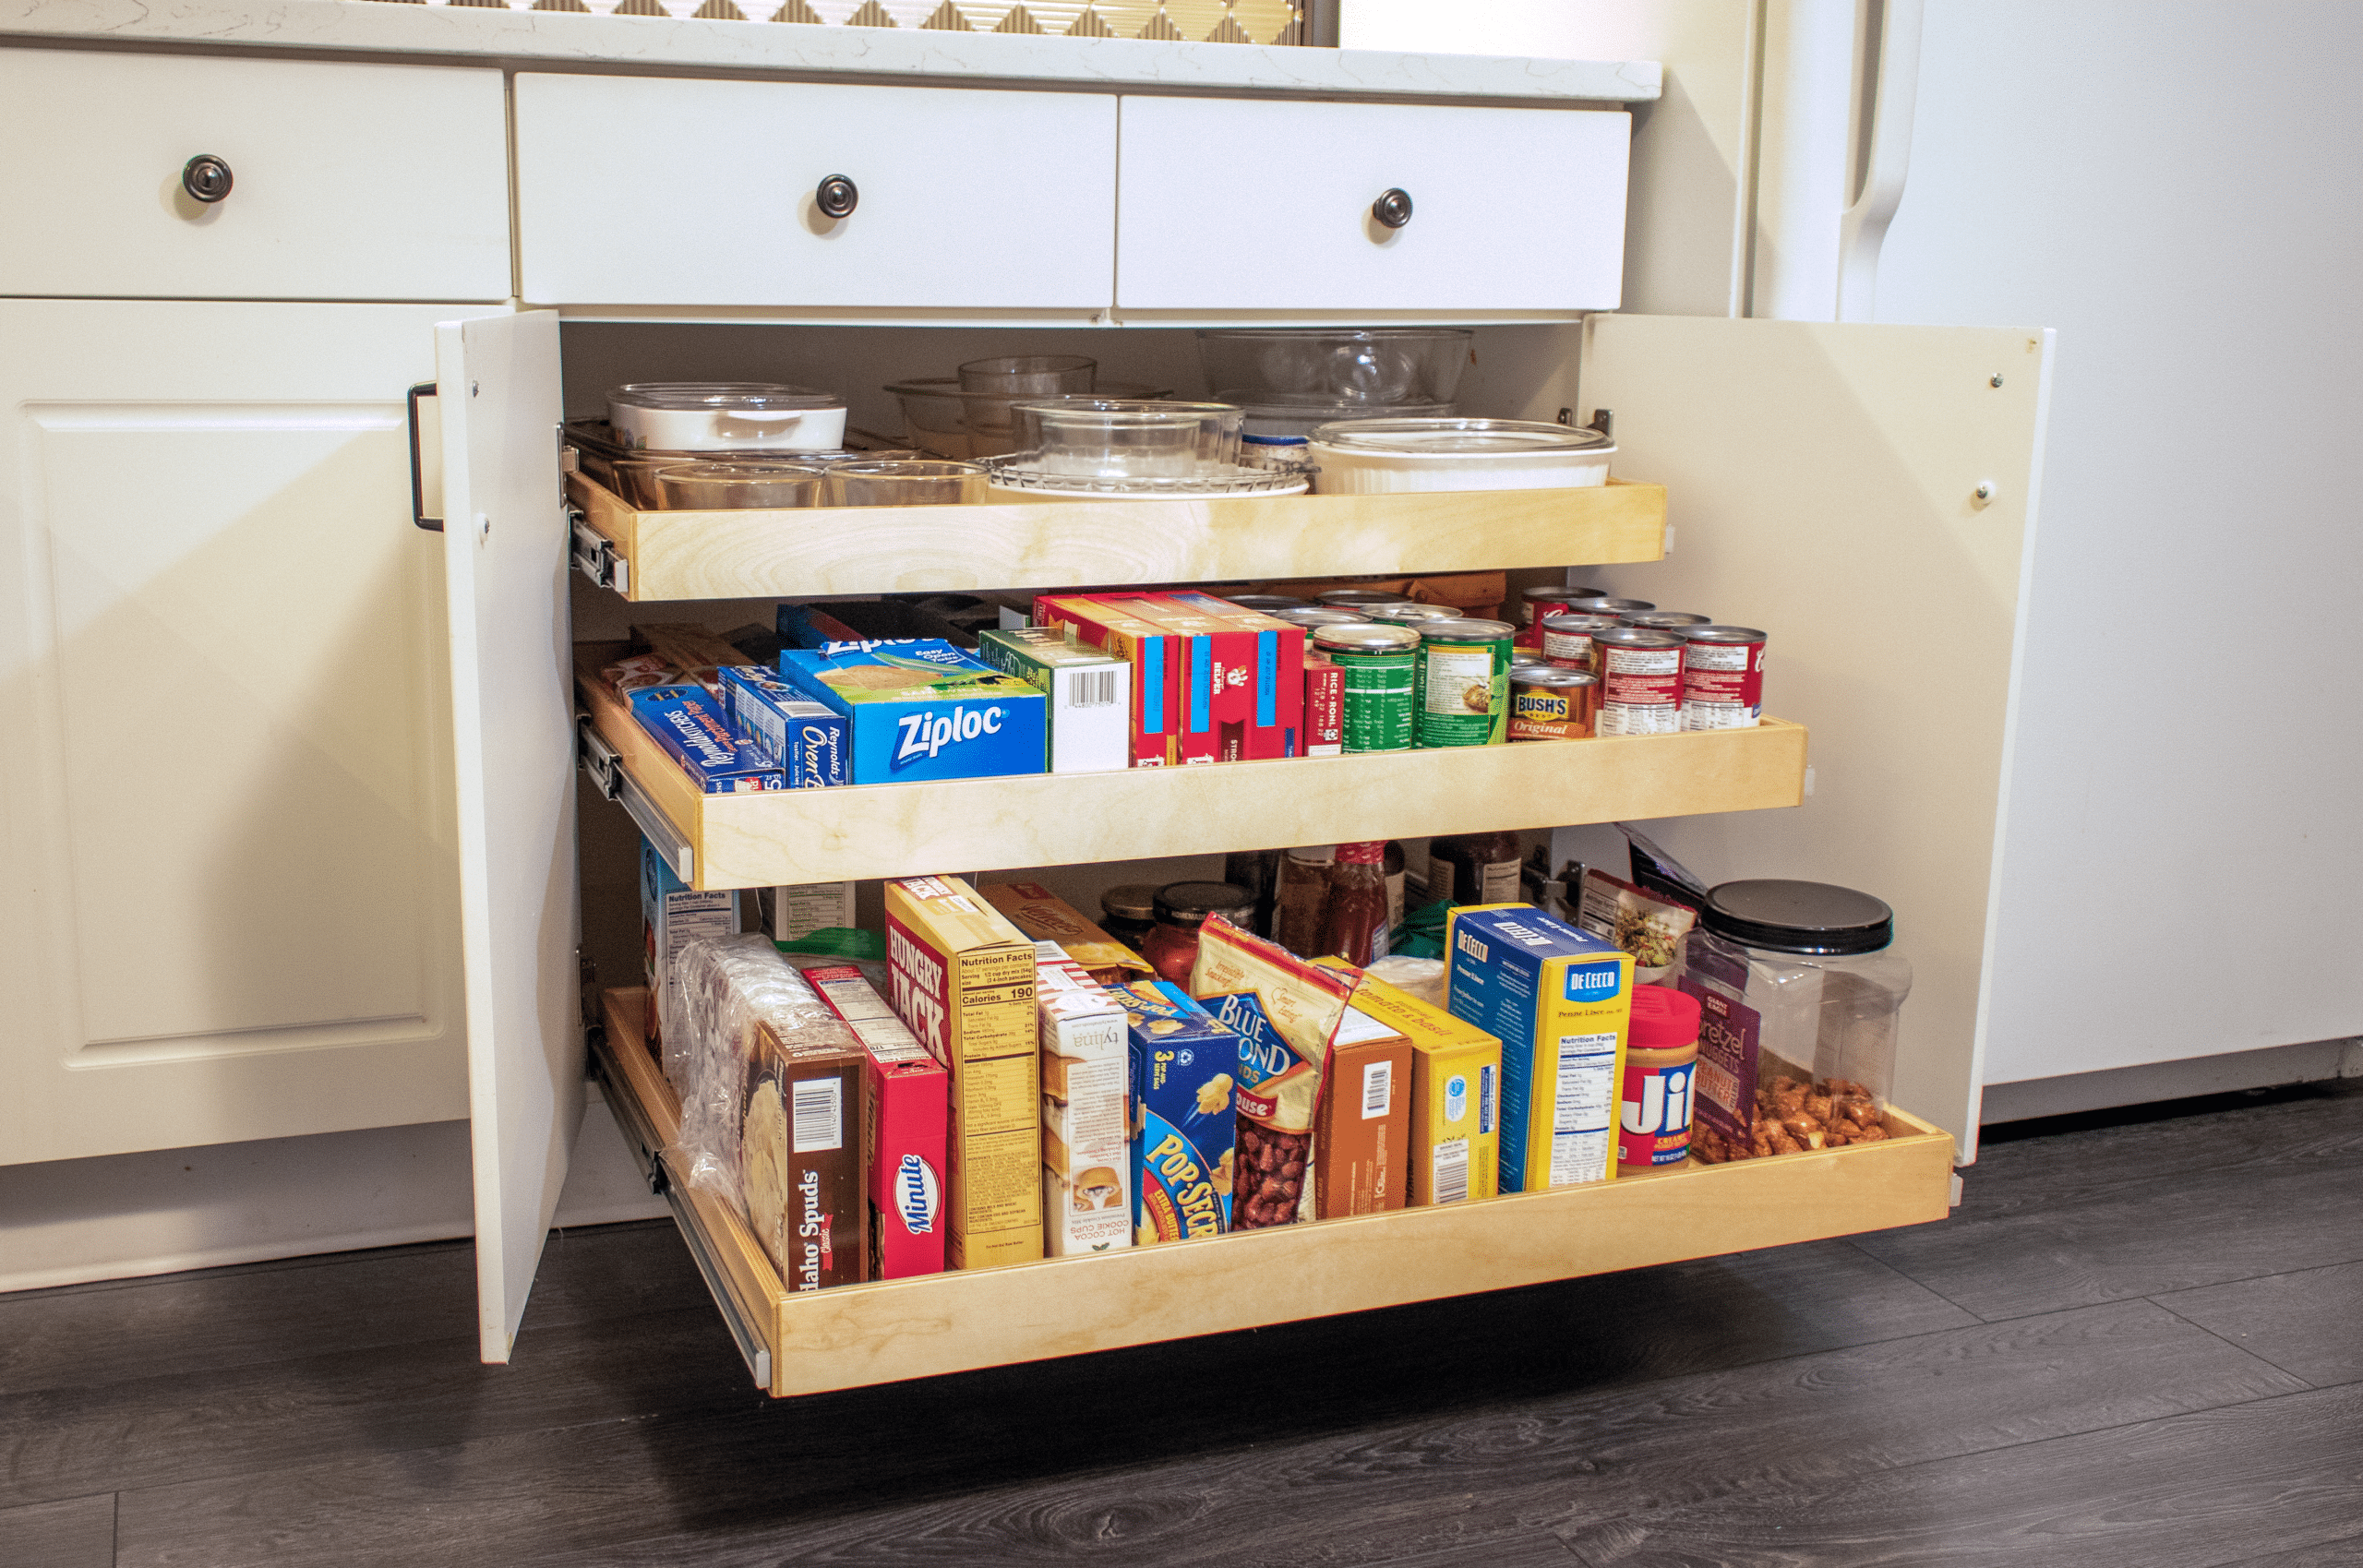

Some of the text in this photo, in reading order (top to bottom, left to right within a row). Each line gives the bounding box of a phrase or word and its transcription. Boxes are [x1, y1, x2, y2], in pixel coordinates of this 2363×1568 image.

[916, 648, 942, 657] Easy
[923, 652, 956, 662] Open
[1212, 661, 1222, 695] HELPER
[1329, 672, 1338, 695] RICE
[1518, 696, 1567, 715] BUSH'S
[664, 710, 703, 743] KITCHENS
[898, 706, 1002, 760] Ziploc
[1514, 720, 1568, 736] Original
[802, 725, 828, 775] Oven
[827, 725, 841, 775] Reynolds
[668, 891, 726, 902] Nutrition Facts
[890, 925, 942, 999] HUNGRY
[961, 952, 1033, 966] Nutrition Facts
[962, 973, 980, 981] Serving
[1571, 972, 1615, 990] DE CECCO
[962, 987, 1033, 1004] Calories 190
[1277, 990, 1298, 1008] Smart
[1708, 995, 1728, 1010] GIANT
[891, 963, 949, 1069] JACK
[1217, 994, 1267, 1044] BLUE
[1356, 987, 1404, 1014] tomato
[1412, 1018, 1454, 1036] basil
[1708, 1001, 1728, 1017] EAGLE
[1074, 1026, 1119, 1051] tylina
[1561, 1034, 1616, 1045] Nutrition Facts
[1155, 1050, 1175, 1062] 3
[1698, 1039, 1740, 1074] NUGGETS
[1696, 1070, 1731, 1102] BUTTER
[1697, 1059, 1732, 1088] PEANUT
[1146, 1133, 1200, 1187] POP
[799, 1171, 826, 1240] Spuds
[900, 1155, 934, 1235] Minute
[1154, 1189, 1172, 1214] EXTRA
[1070, 1219, 1130, 1235] COOKIE CUPS
[1074, 1227, 1125, 1240] HOT COCOA
[820, 1228, 832, 1253] Classic
